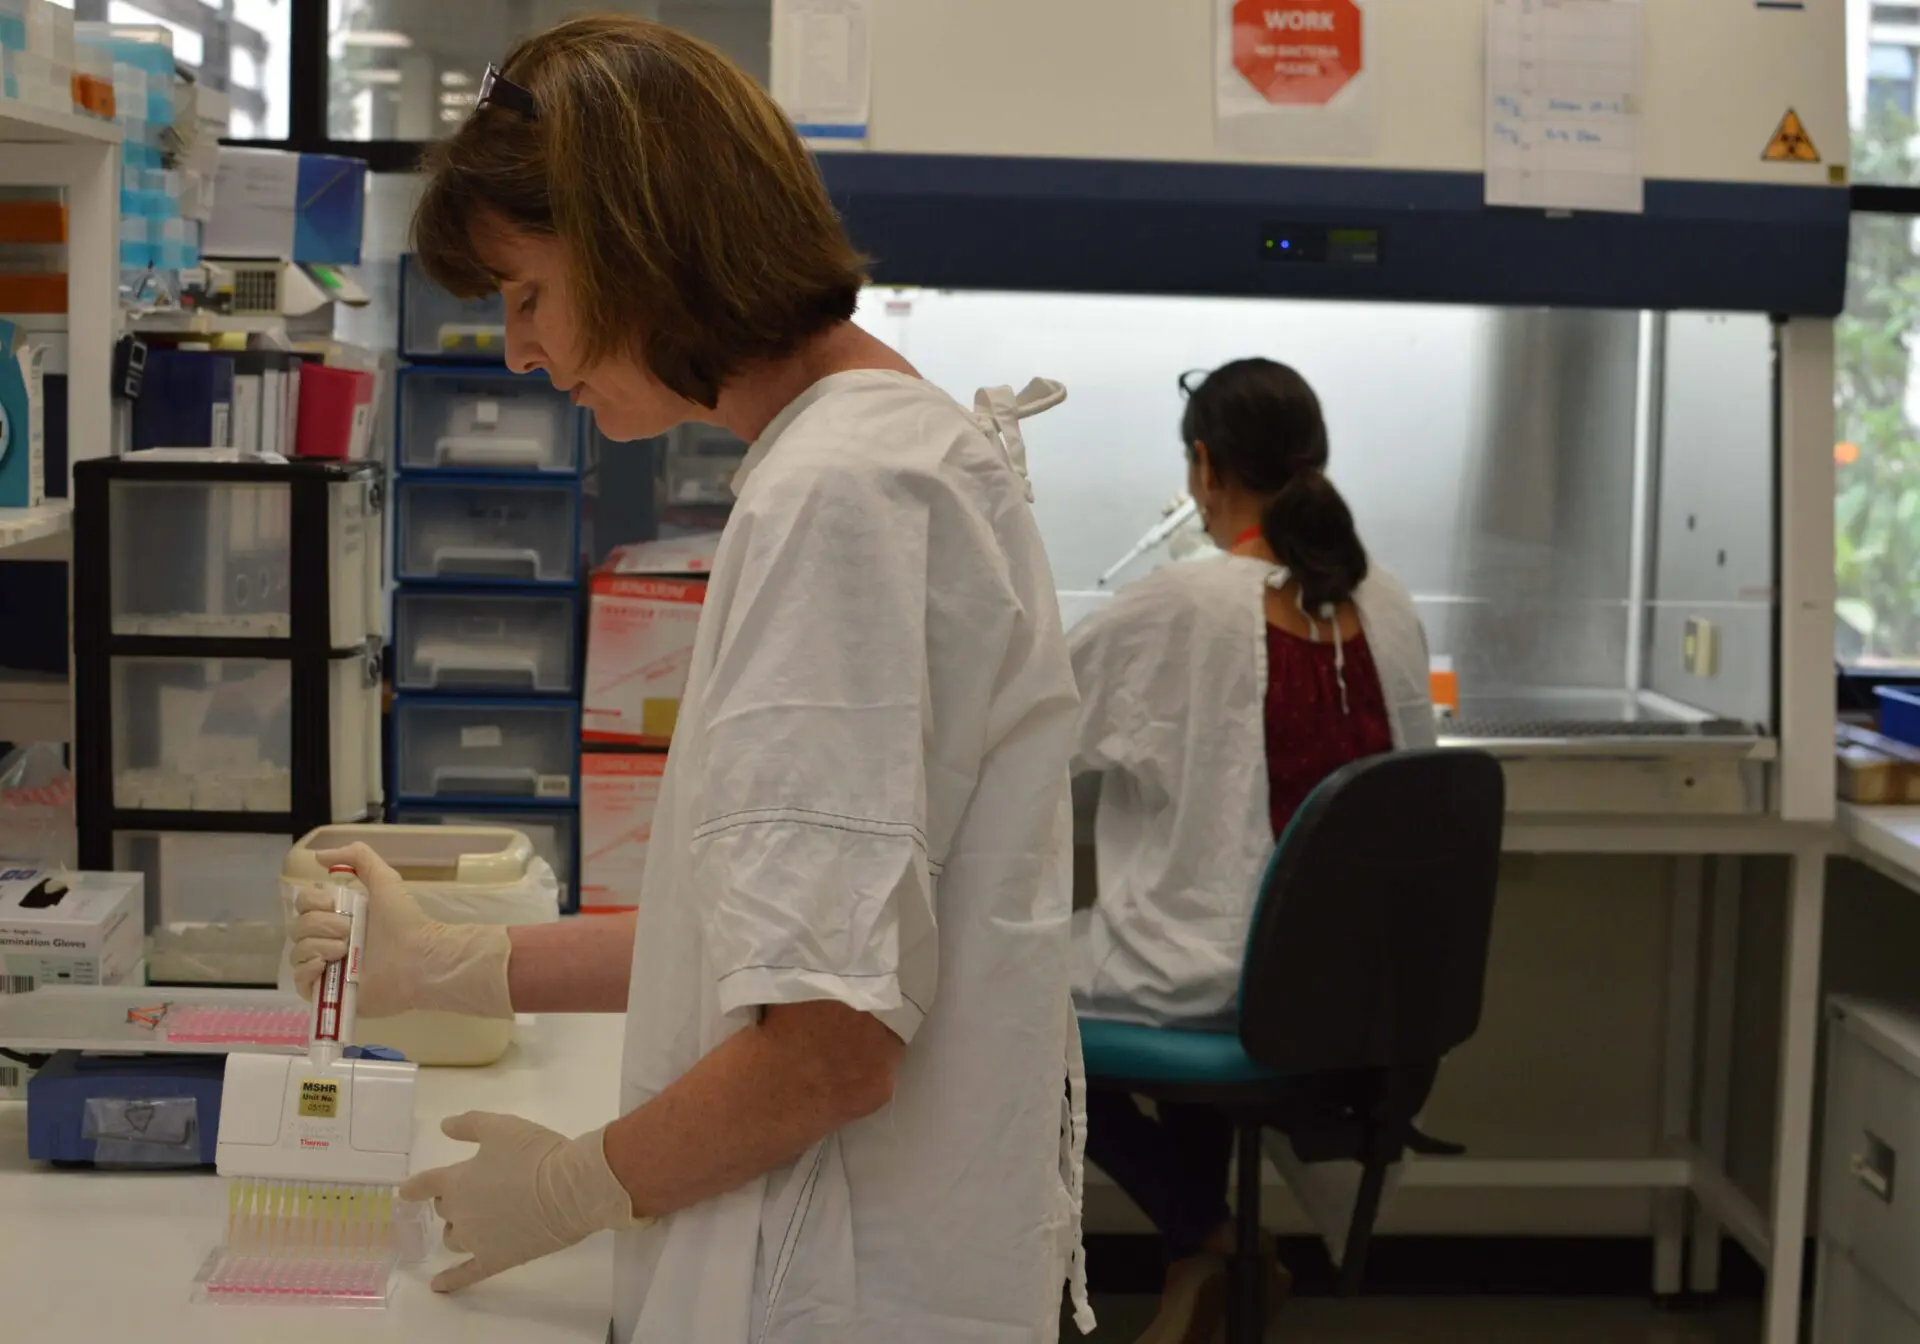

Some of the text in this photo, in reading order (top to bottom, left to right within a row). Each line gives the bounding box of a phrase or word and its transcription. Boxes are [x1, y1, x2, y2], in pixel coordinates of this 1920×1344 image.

[1263, 10, 1335, 32] WORK
[52, 938, 86, 949] Gloves
[303, 1083, 337, 1093] MSHR
[302, 1093, 319, 1101] Unit
[300, 1138, 330, 1147] Thermo
